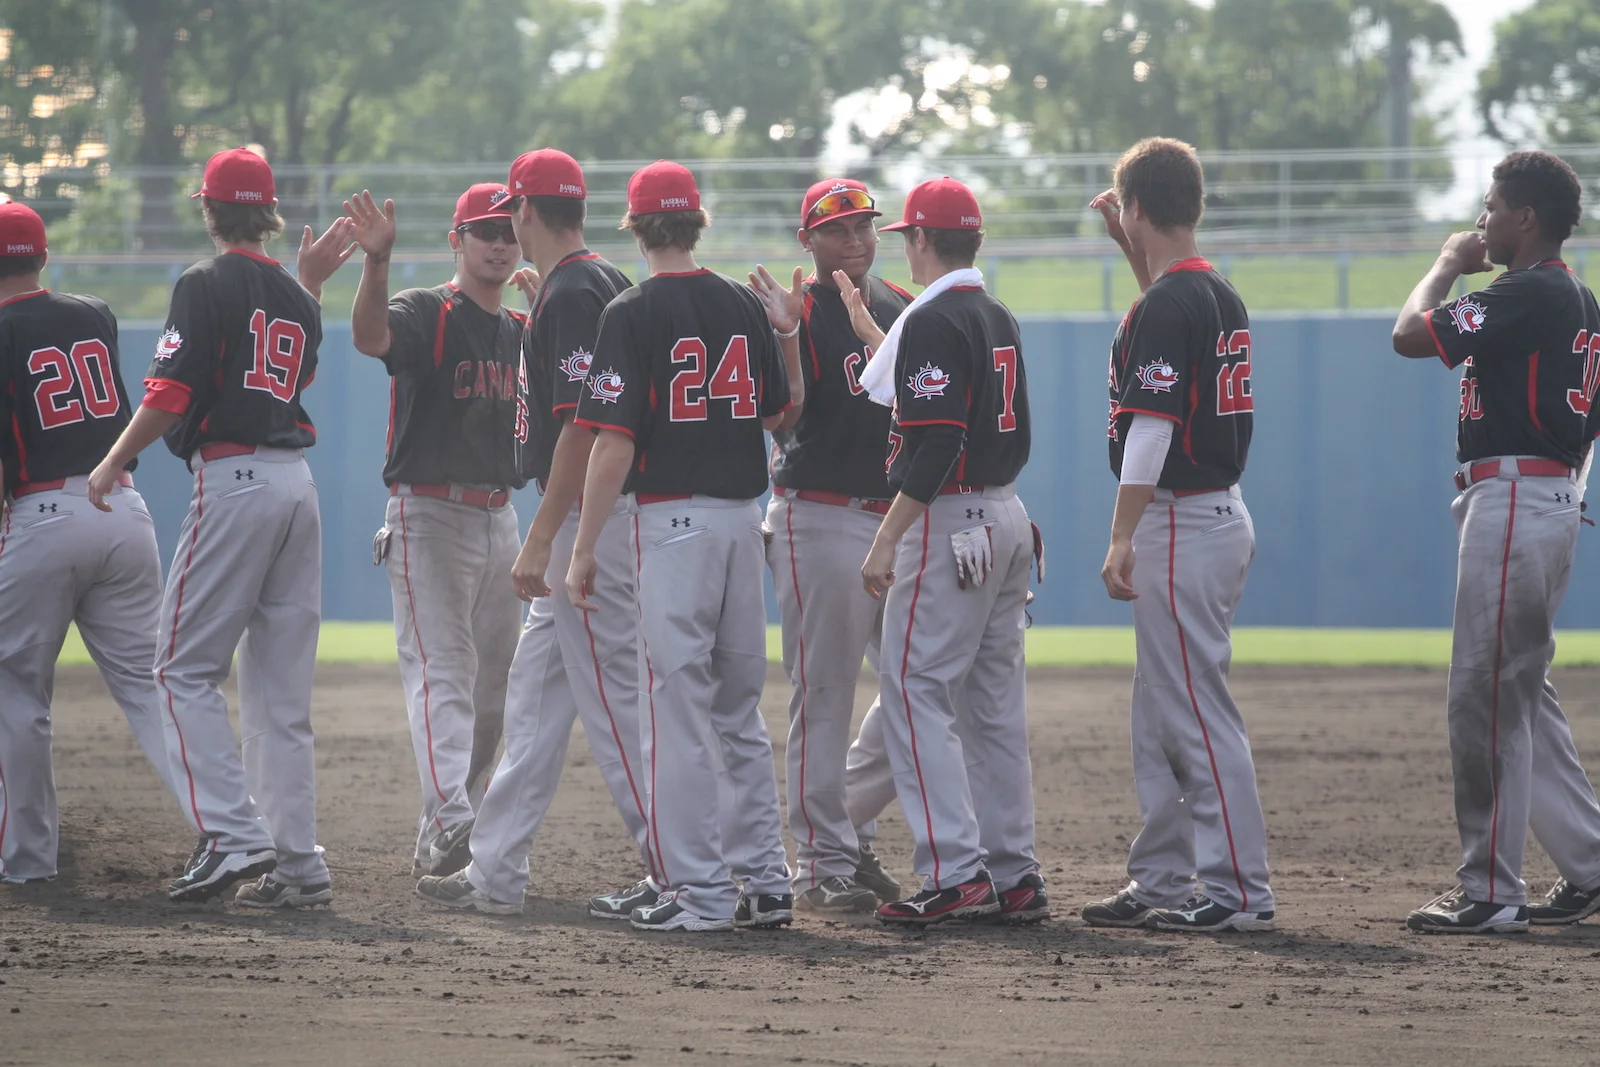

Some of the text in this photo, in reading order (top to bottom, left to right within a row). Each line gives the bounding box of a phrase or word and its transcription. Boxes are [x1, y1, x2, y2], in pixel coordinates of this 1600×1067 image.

[235, 190, 263, 198] BASEBALL
[660, 197, 688, 205] BASEBALL
[27, 338, 120, 430] 20
[243, 308, 306, 403] 19
[454, 360, 519, 401] CANA
[669, 334, 757, 422] 24
[993, 345, 1017, 433] 7
[1216, 329, 1254, 416] 22
[885, 431, 903, 474] 7
